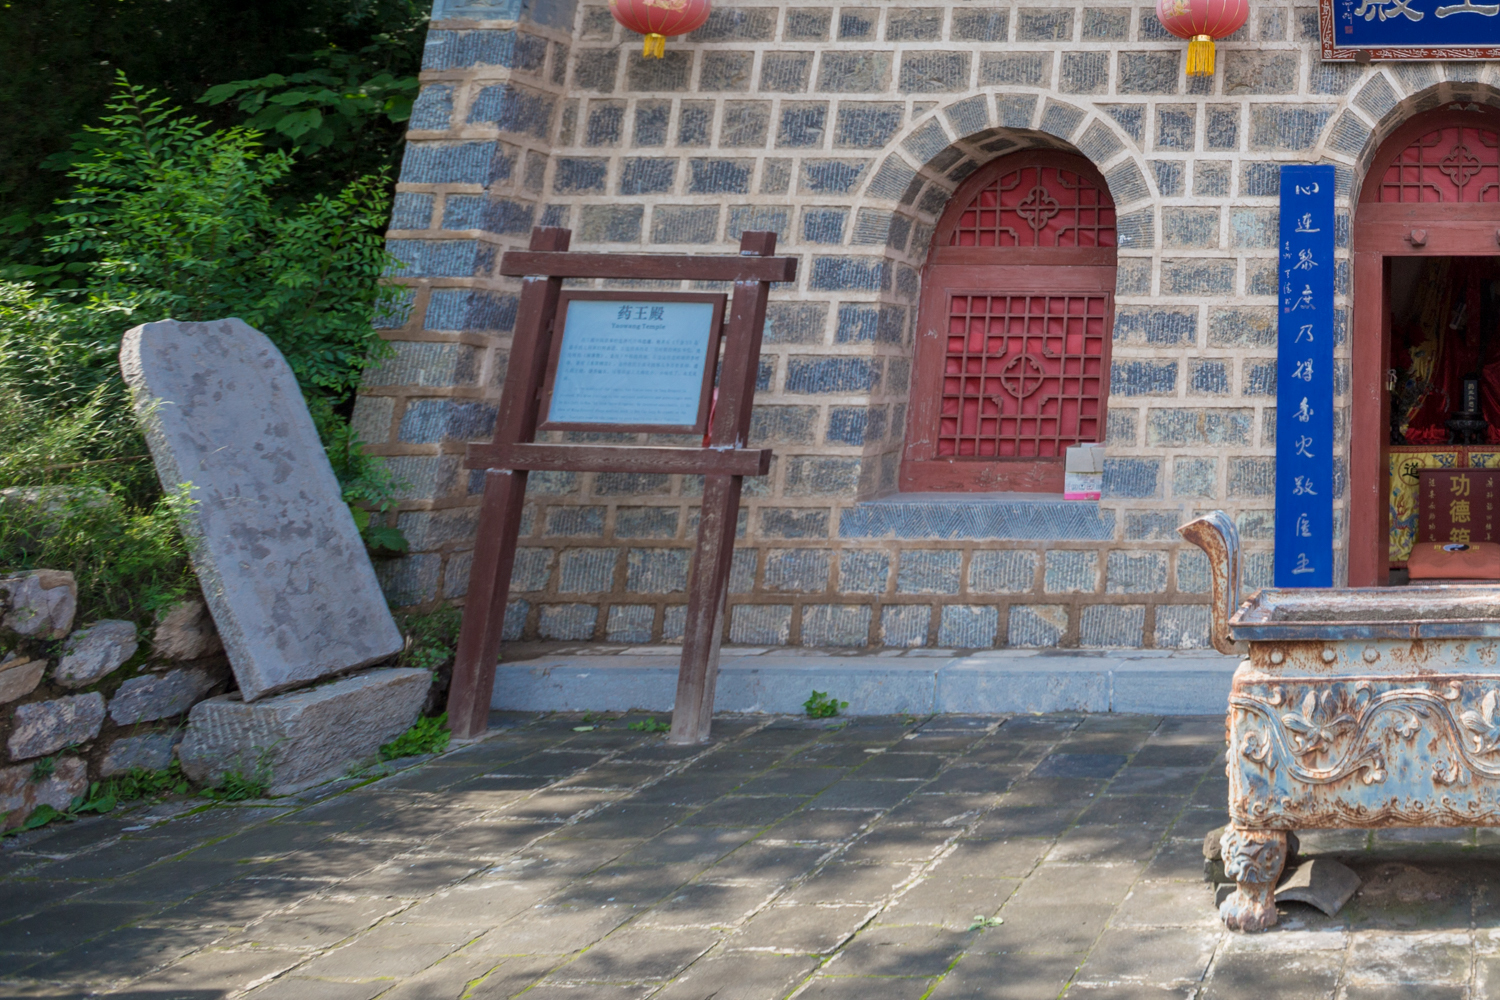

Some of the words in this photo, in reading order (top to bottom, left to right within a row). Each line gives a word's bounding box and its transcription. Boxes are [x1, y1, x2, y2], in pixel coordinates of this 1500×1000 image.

[616, 304, 665, 321] 药王殿
[611, 322, 641, 330] Yaowang
[642, 323, 666, 331] Temple
[1402, 462, 1420, 479] 道
